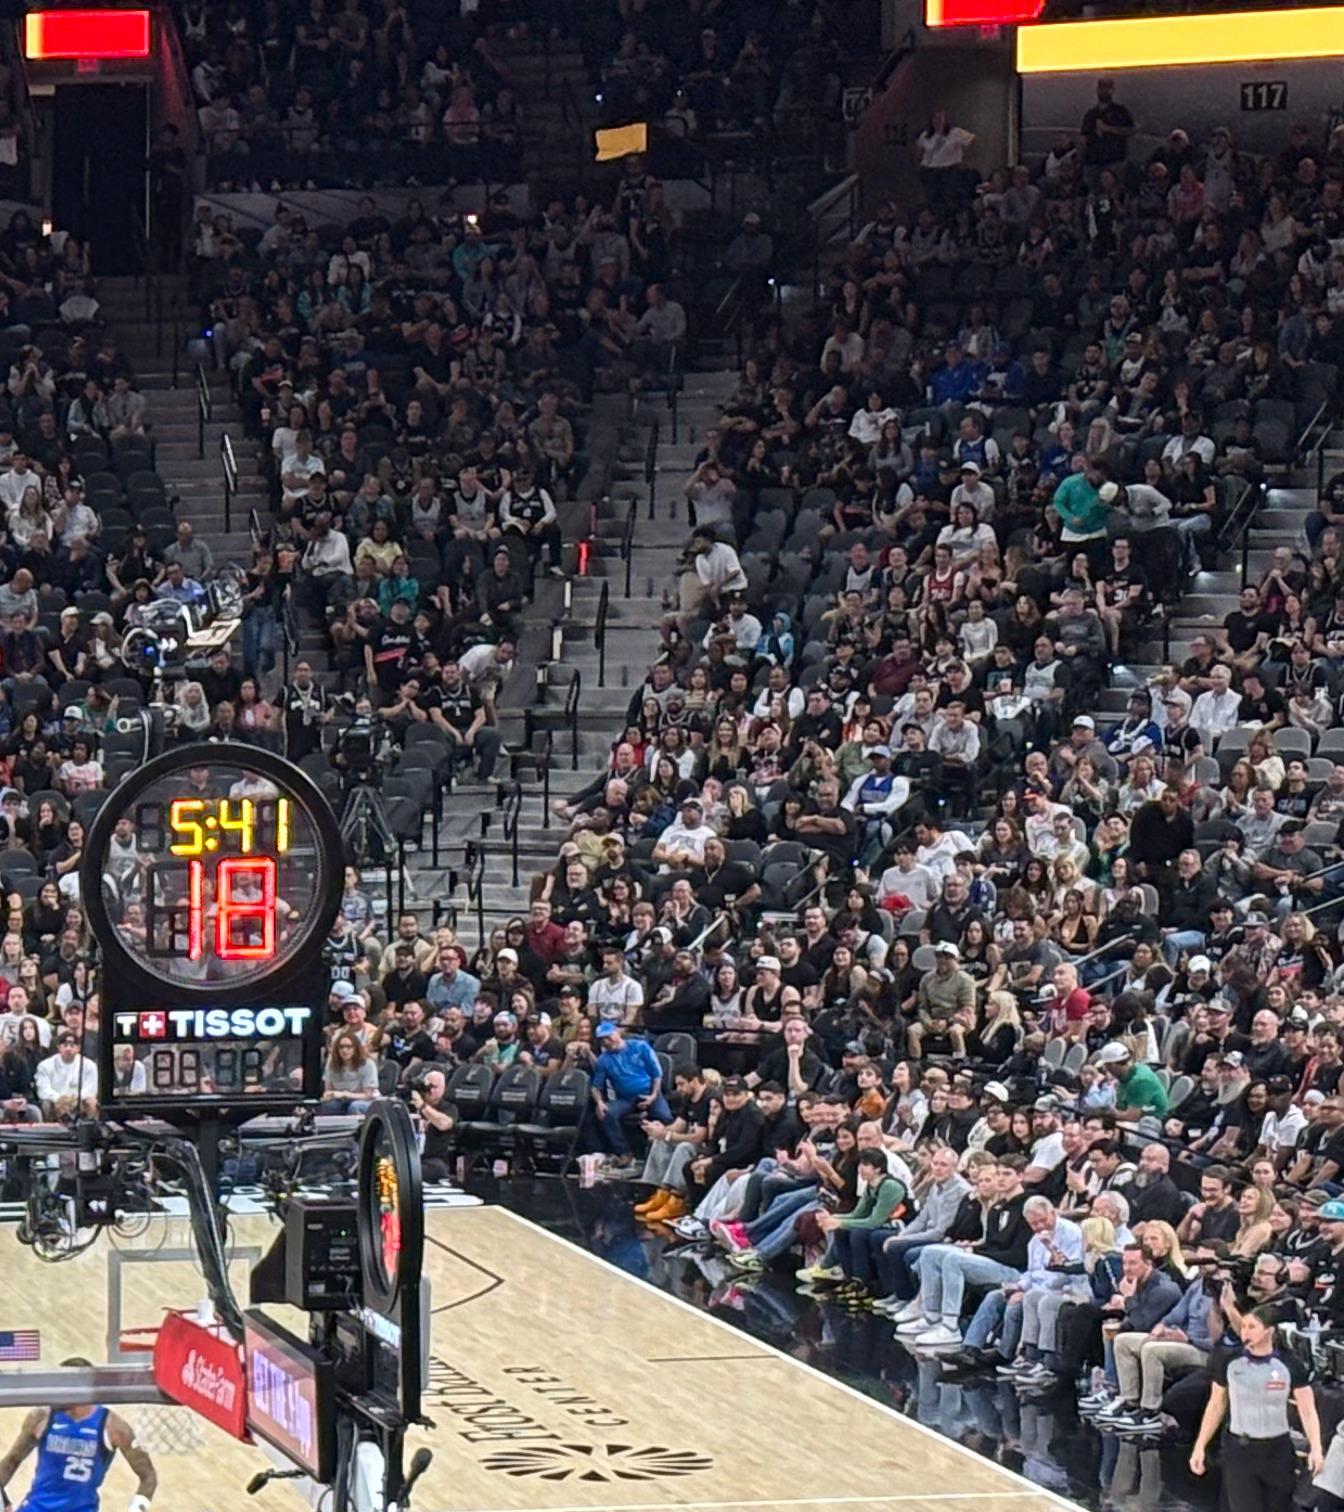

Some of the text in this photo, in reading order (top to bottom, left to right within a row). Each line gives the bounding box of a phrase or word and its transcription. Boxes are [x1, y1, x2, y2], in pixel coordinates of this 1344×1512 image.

[1245, 83, 1285, 109] 117
[170, 797, 290, 856] 5:41
[188, 856, 277, 960] 18
[169, 1007, 311, 1038] TISSOT
[501, 1366, 630, 1427] CENTER
[62, 1456, 95, 1483] 25
